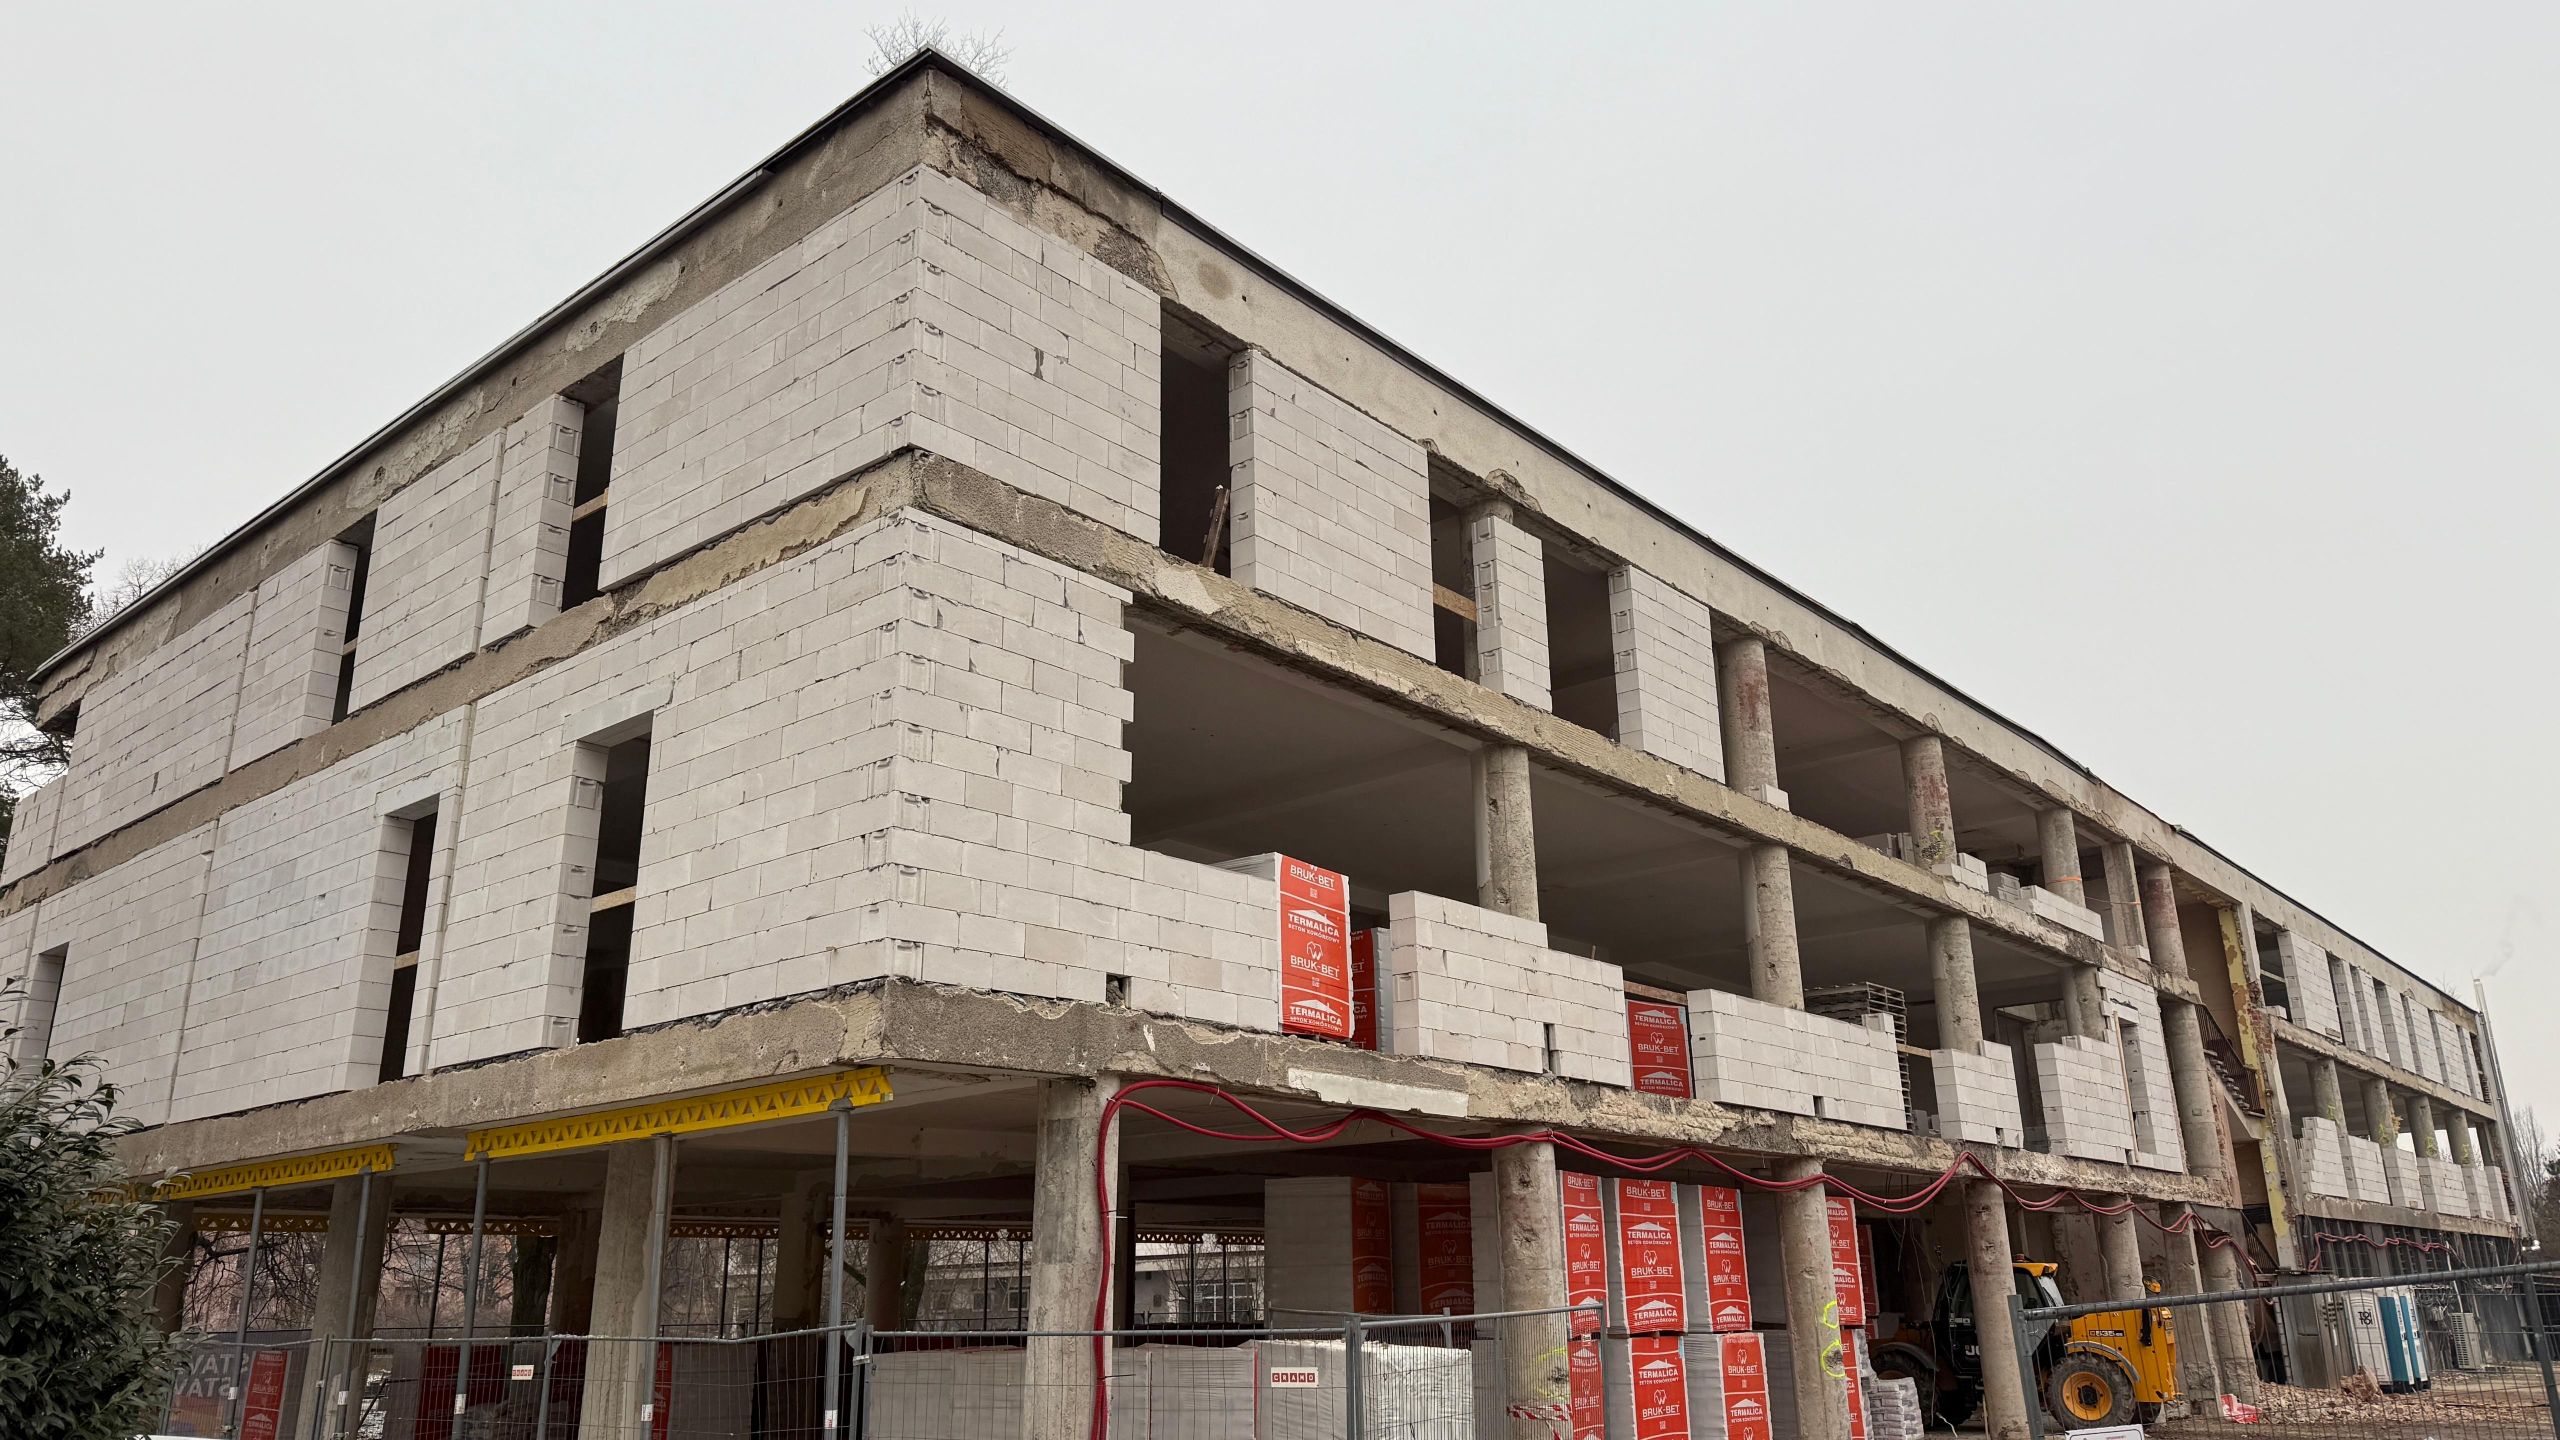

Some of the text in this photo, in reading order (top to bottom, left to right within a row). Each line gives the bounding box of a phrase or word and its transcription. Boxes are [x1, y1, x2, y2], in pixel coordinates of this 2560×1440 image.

[1290, 864, 1335, 888] BRUK-BET
[1288, 913, 1340, 937] TERMALICA
[1290, 955, 1340, 978] BRUK-BET
[1289, 1006, 1343, 1027] TERMALICA
[1634, 1014, 1677, 1025] TERMALICA
[1637, 1043, 1679, 1053] BRUK-BET
[1640, 1078, 1684, 1087] TERMALICA
[1567, 1175, 1594, 1187] BRUK-BET
[1626, 1186, 1665, 1197] BRUK-BET
[1707, 1199, 1734, 1209] BRUK-BET
[1569, 1223, 1600, 1232] TERMALICA
[1627, 1231, 1672, 1240] TERMALICA
[1709, 1241, 1739, 1250] TERMALICA
[1572, 1260, 1600, 1271] BRUK-BET
[1631, 1266, 1673, 1276] BRUK-BET
[1713, 1275, 1741, 1283] BRUK-BET
[1633, 1309, 1678, 1320] TERMALICA
[1716, 1315, 1746, 1324] TERMALICA
[1638, 1369, 1678, 1379] TERMALICA
[1727, 1364, 1758, 1374] BRUK-BET
[1642, 1404, 1680, 1418] BRUK-BET
[1730, 1408, 1763, 1417] TERMALICA
